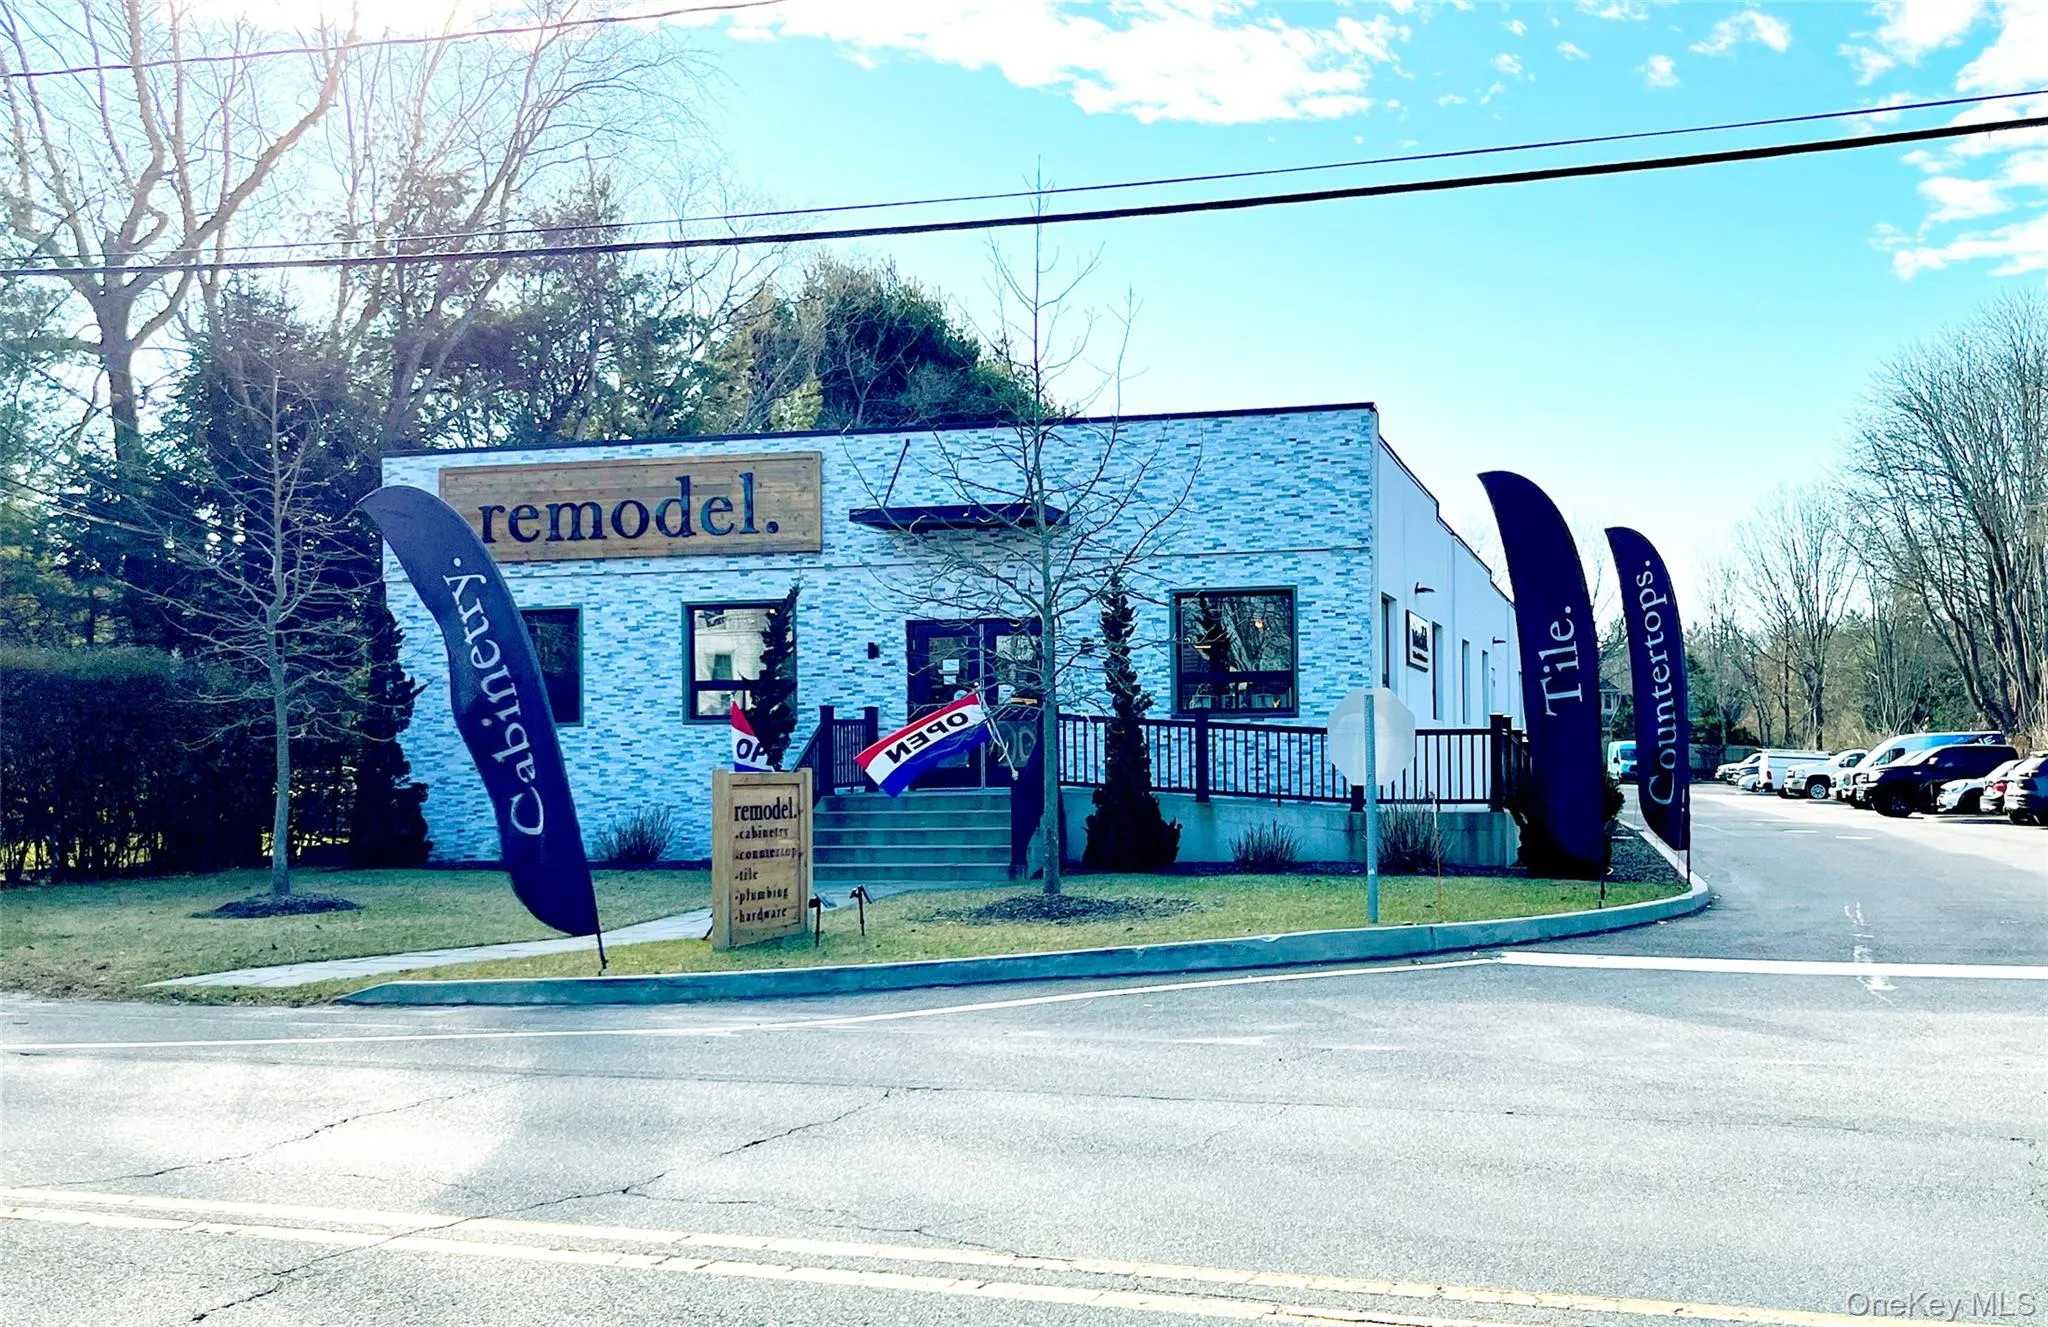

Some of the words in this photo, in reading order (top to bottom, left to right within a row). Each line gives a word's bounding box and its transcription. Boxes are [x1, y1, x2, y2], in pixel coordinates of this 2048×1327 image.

[478, 472, 779, 543] remodel.
[442, 557, 544, 835] Cabinetry.
[1538, 605, 1583, 717] Tile.
[1635, 560, 1676, 805] Countertops.
[736, 738, 766, 763] OP
[734, 796, 798, 821] remodel.
